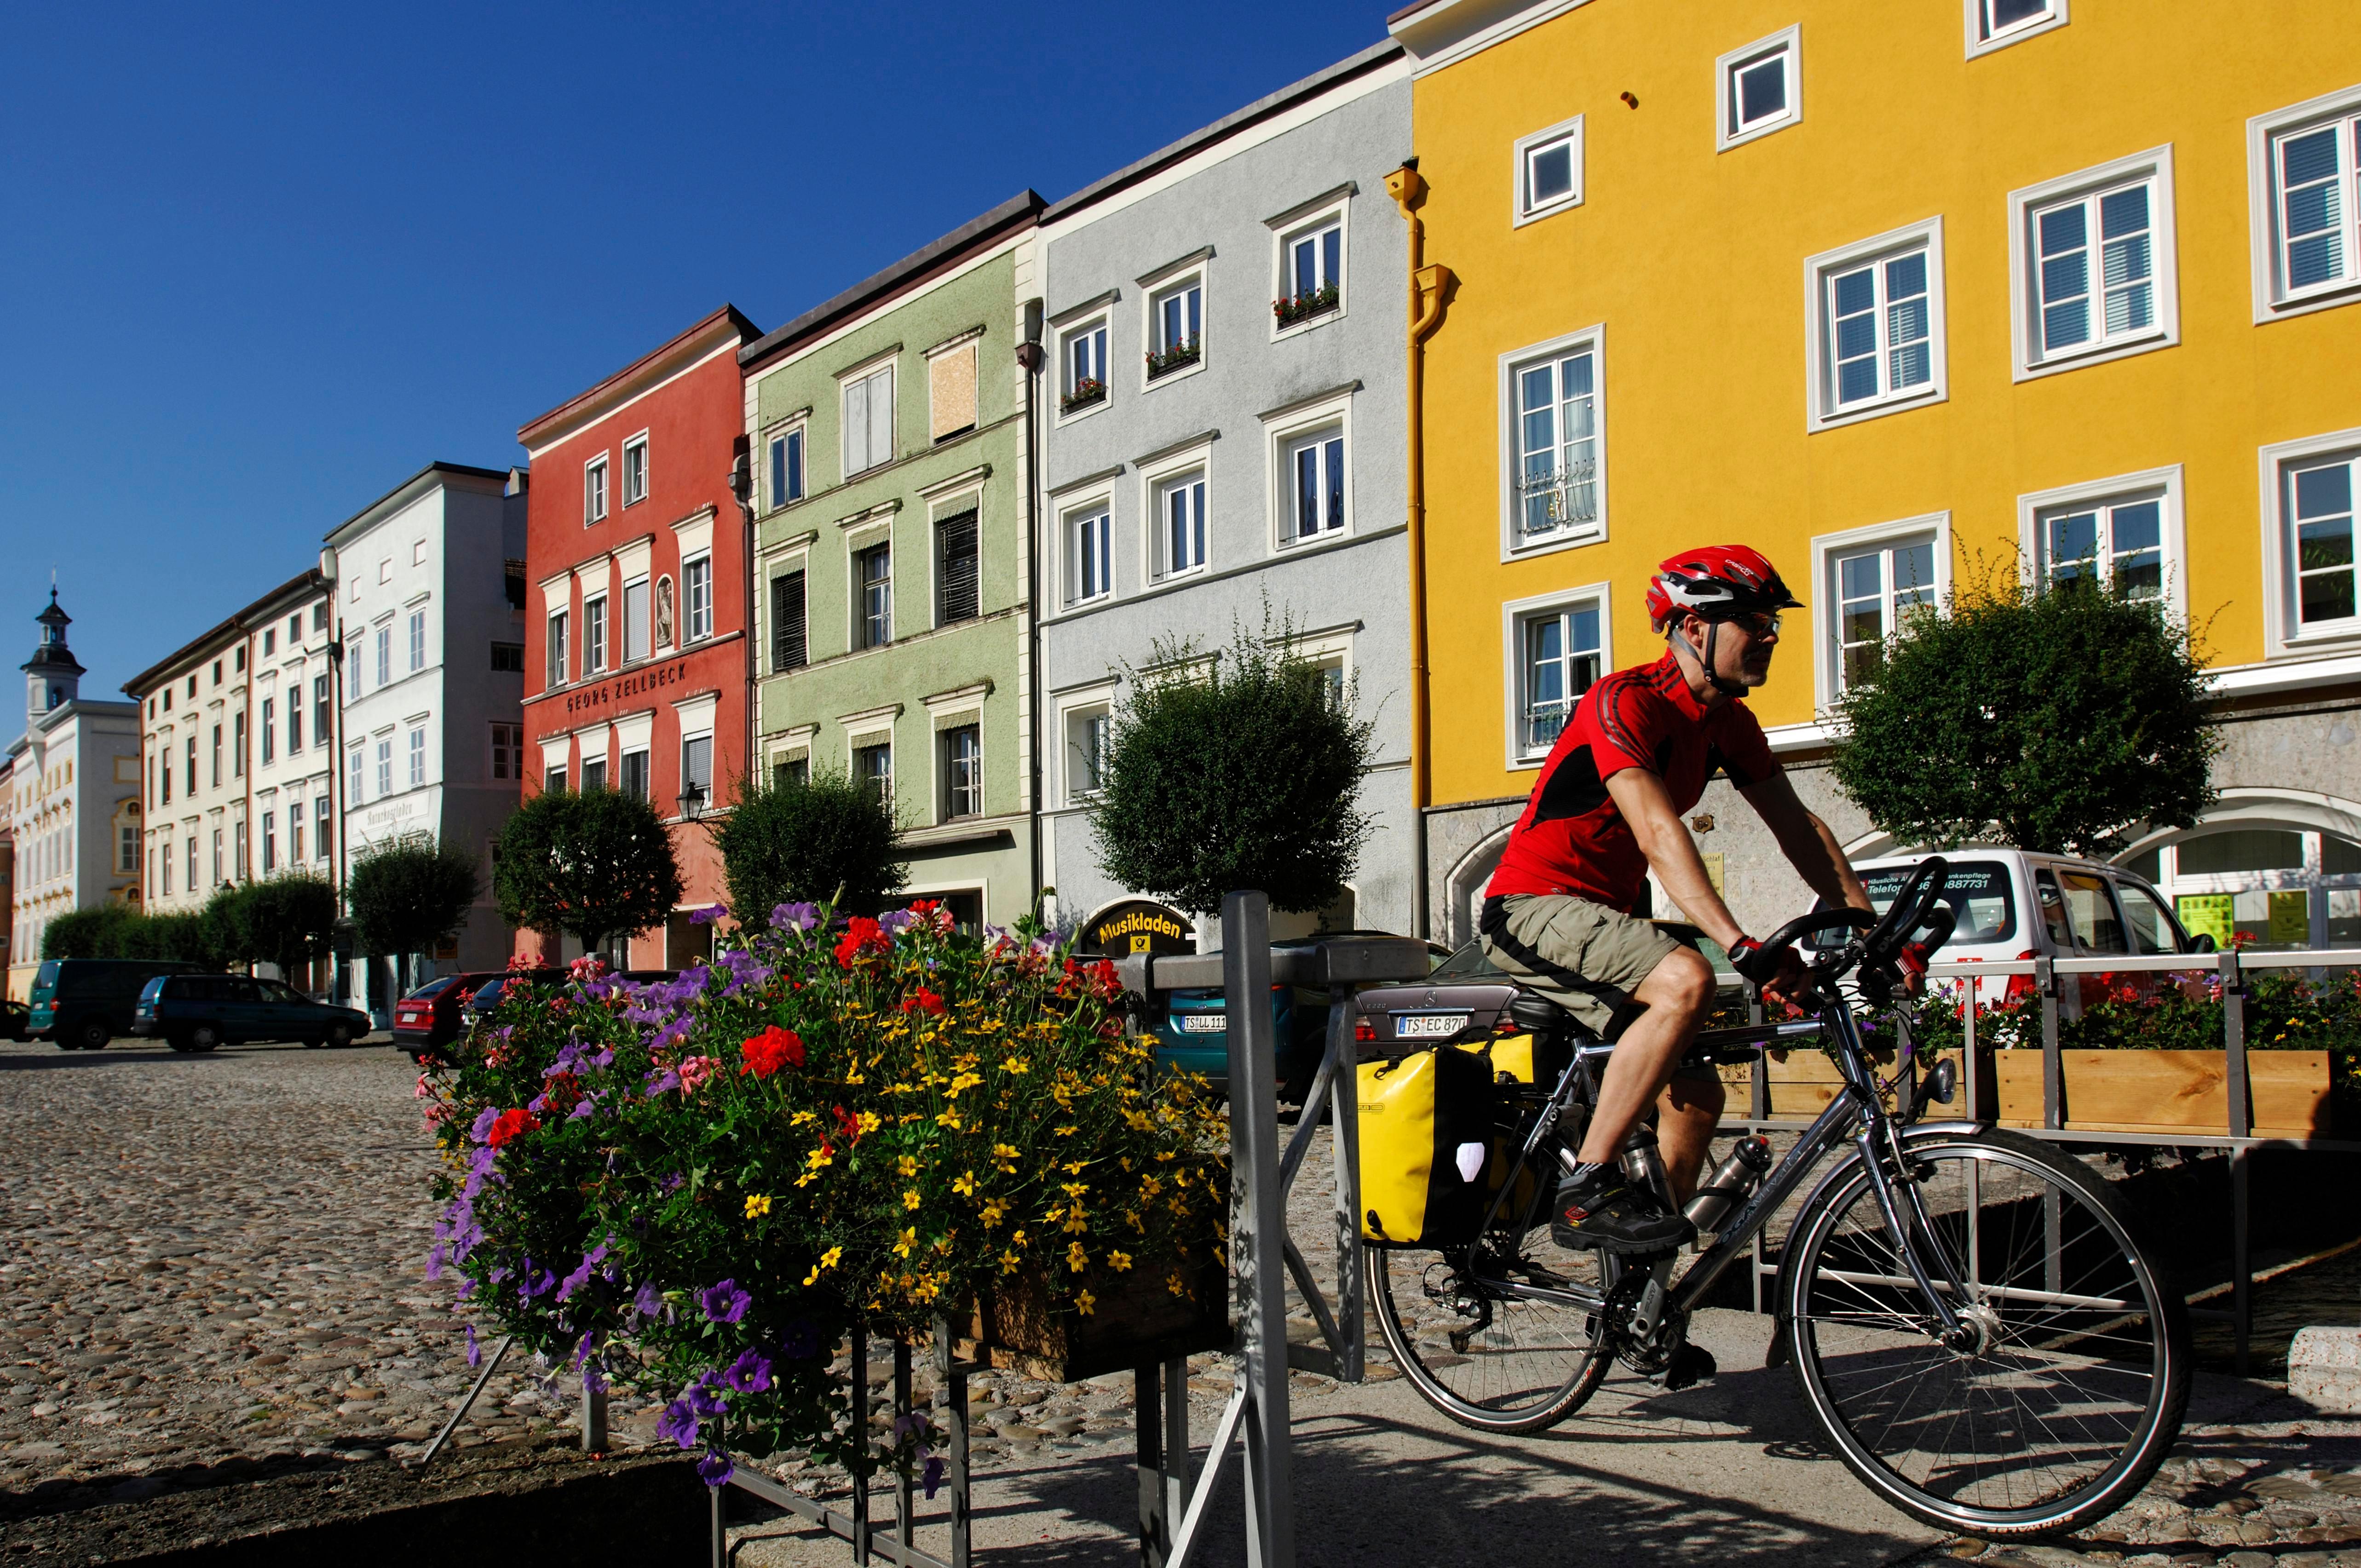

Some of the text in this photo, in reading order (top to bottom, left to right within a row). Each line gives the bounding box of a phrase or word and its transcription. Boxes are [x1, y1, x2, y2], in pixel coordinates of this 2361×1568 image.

[567, 662, 686, 712] GEORG ZELLBECK
[1099, 912, 1180, 944] Musikladen
[1186, 1017, 1226, 1028] TS LL 111
[1407, 1019, 1420, 1032] TS
[1427, 1018, 1441, 1031] EC
[1550, 1373, 1588, 1415] MARATHON
[1987, 1514, 2074, 1533] SCHWALBE
